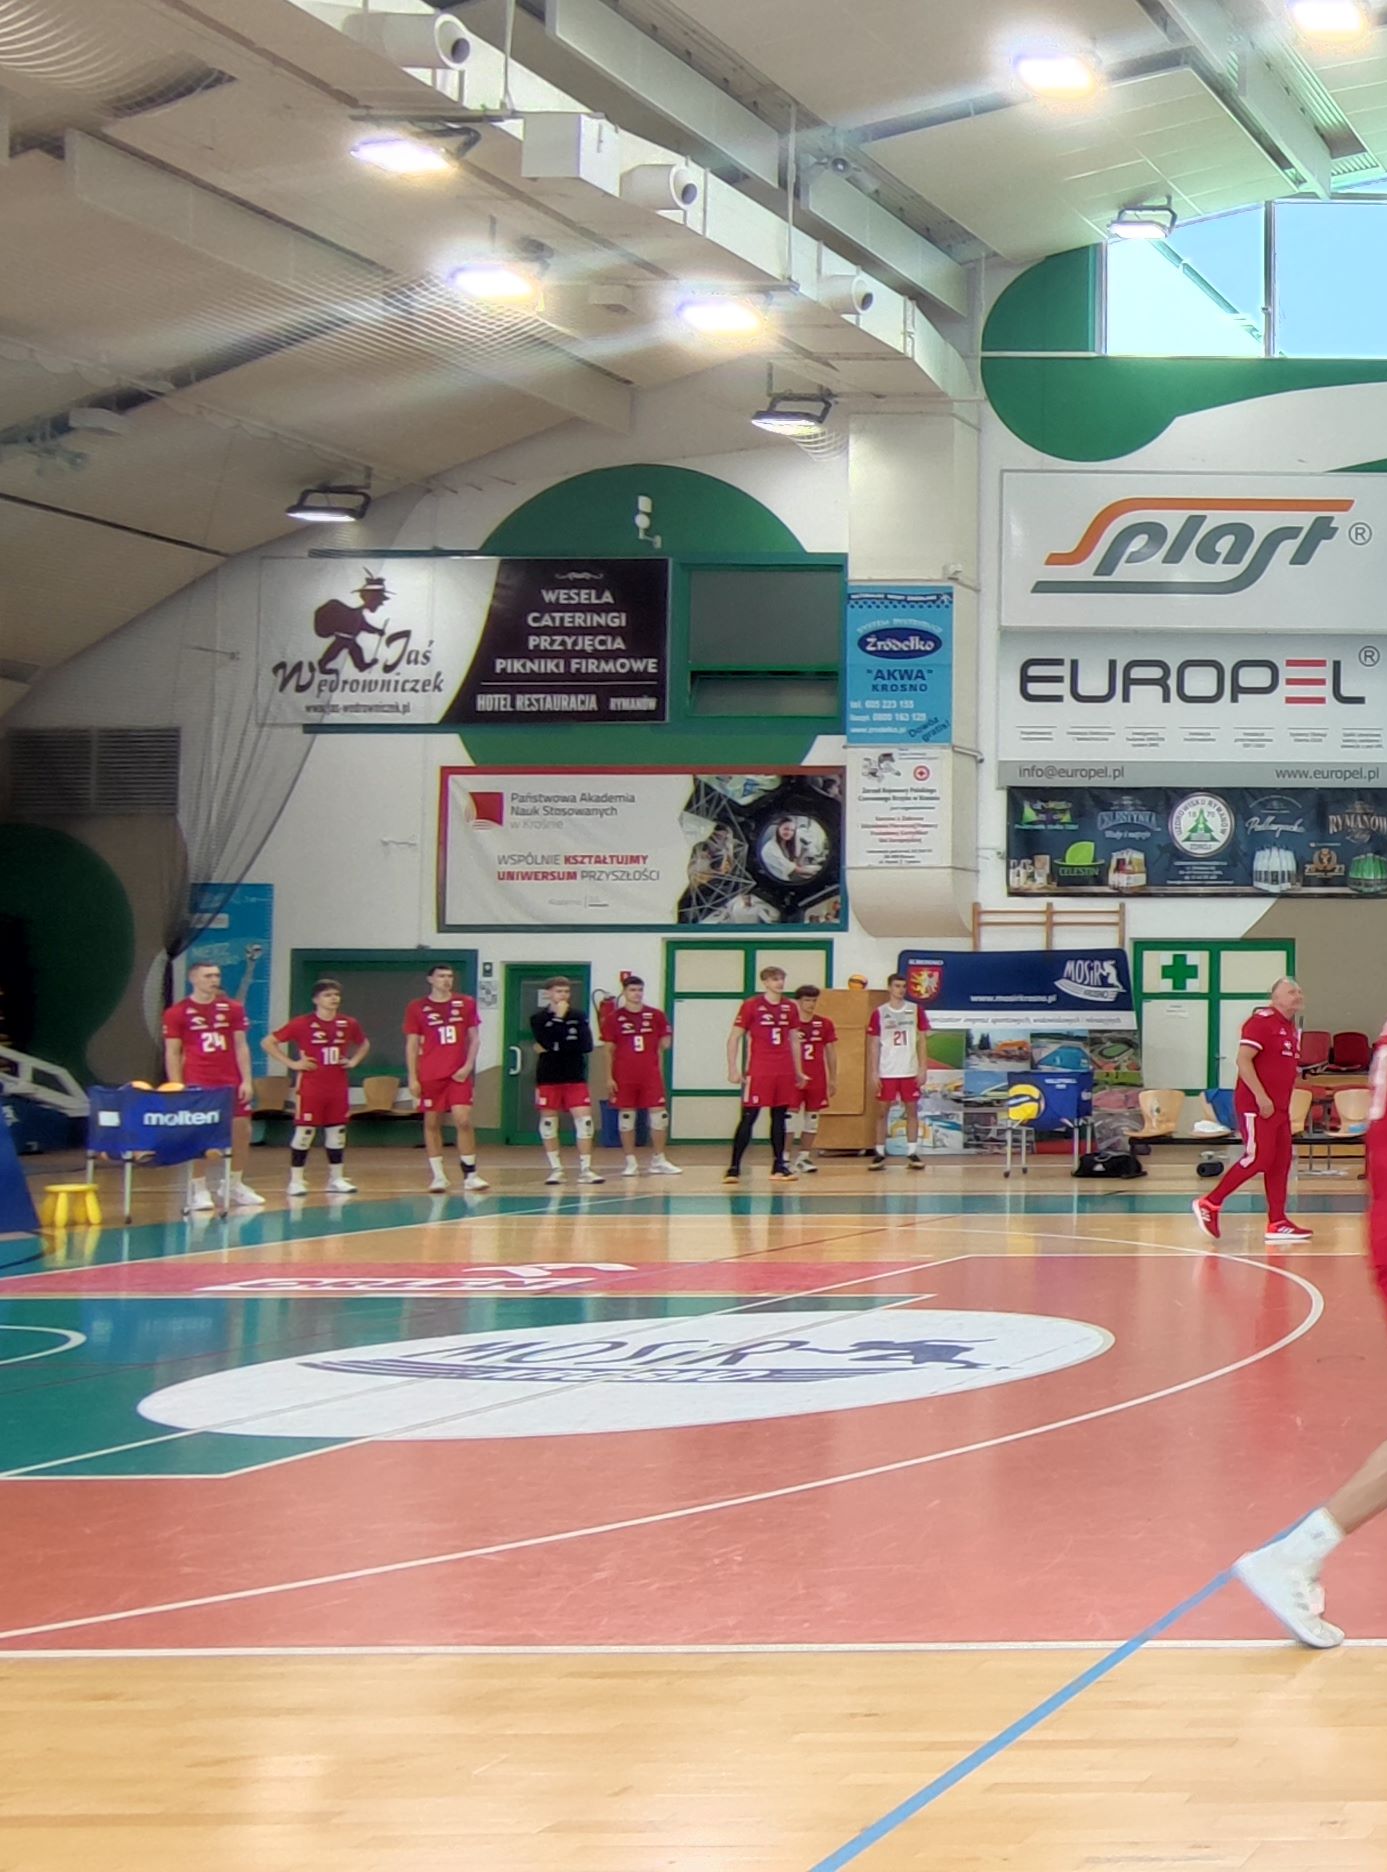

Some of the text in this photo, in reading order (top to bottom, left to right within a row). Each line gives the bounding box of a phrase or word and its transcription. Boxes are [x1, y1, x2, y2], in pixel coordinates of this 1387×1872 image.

[1030, 497, 1356, 595] Splast
[541, 589, 614, 604] WESELA
[527, 612, 627, 627] CATERINGI
[382, 630, 434, 674] Jaś
[528, 636, 626, 652] PRZYJĘCIA
[495, 658, 659, 673] PIKNIKI FIRMOWE
[272, 661, 444, 699] Wędrowniczek
[872, 684, 928, 692] KROSNO
[1020, 658, 1366, 704] EUROPEL
[476, 694, 513, 712] HOTEL
[516, 694, 598, 712] RESTAURACJA
[1019, 765, 1124, 781] info@europel.pl
[1275, 767, 1380, 782] www.europel.pl
[510, 792, 635, 803] Państwowa Akademia
[510, 806, 618, 818] Nauk Stosowanych
[497, 852, 649, 865] WSPÓLNIE KSZTAŁTUJMY
[497, 867, 660, 881] UNIWERSUM PRZYSZŁOŚCI
[201, 1032, 226, 1053] 24
[438, 1025, 457, 1045] 19
[633, 1035, 644, 1051] 9
[771, 1028, 782, 1045] 5
[893, 1030, 908, 1047] 21
[321, 1046, 340, 1065] 10
[143, 1110, 220, 1126] molten
